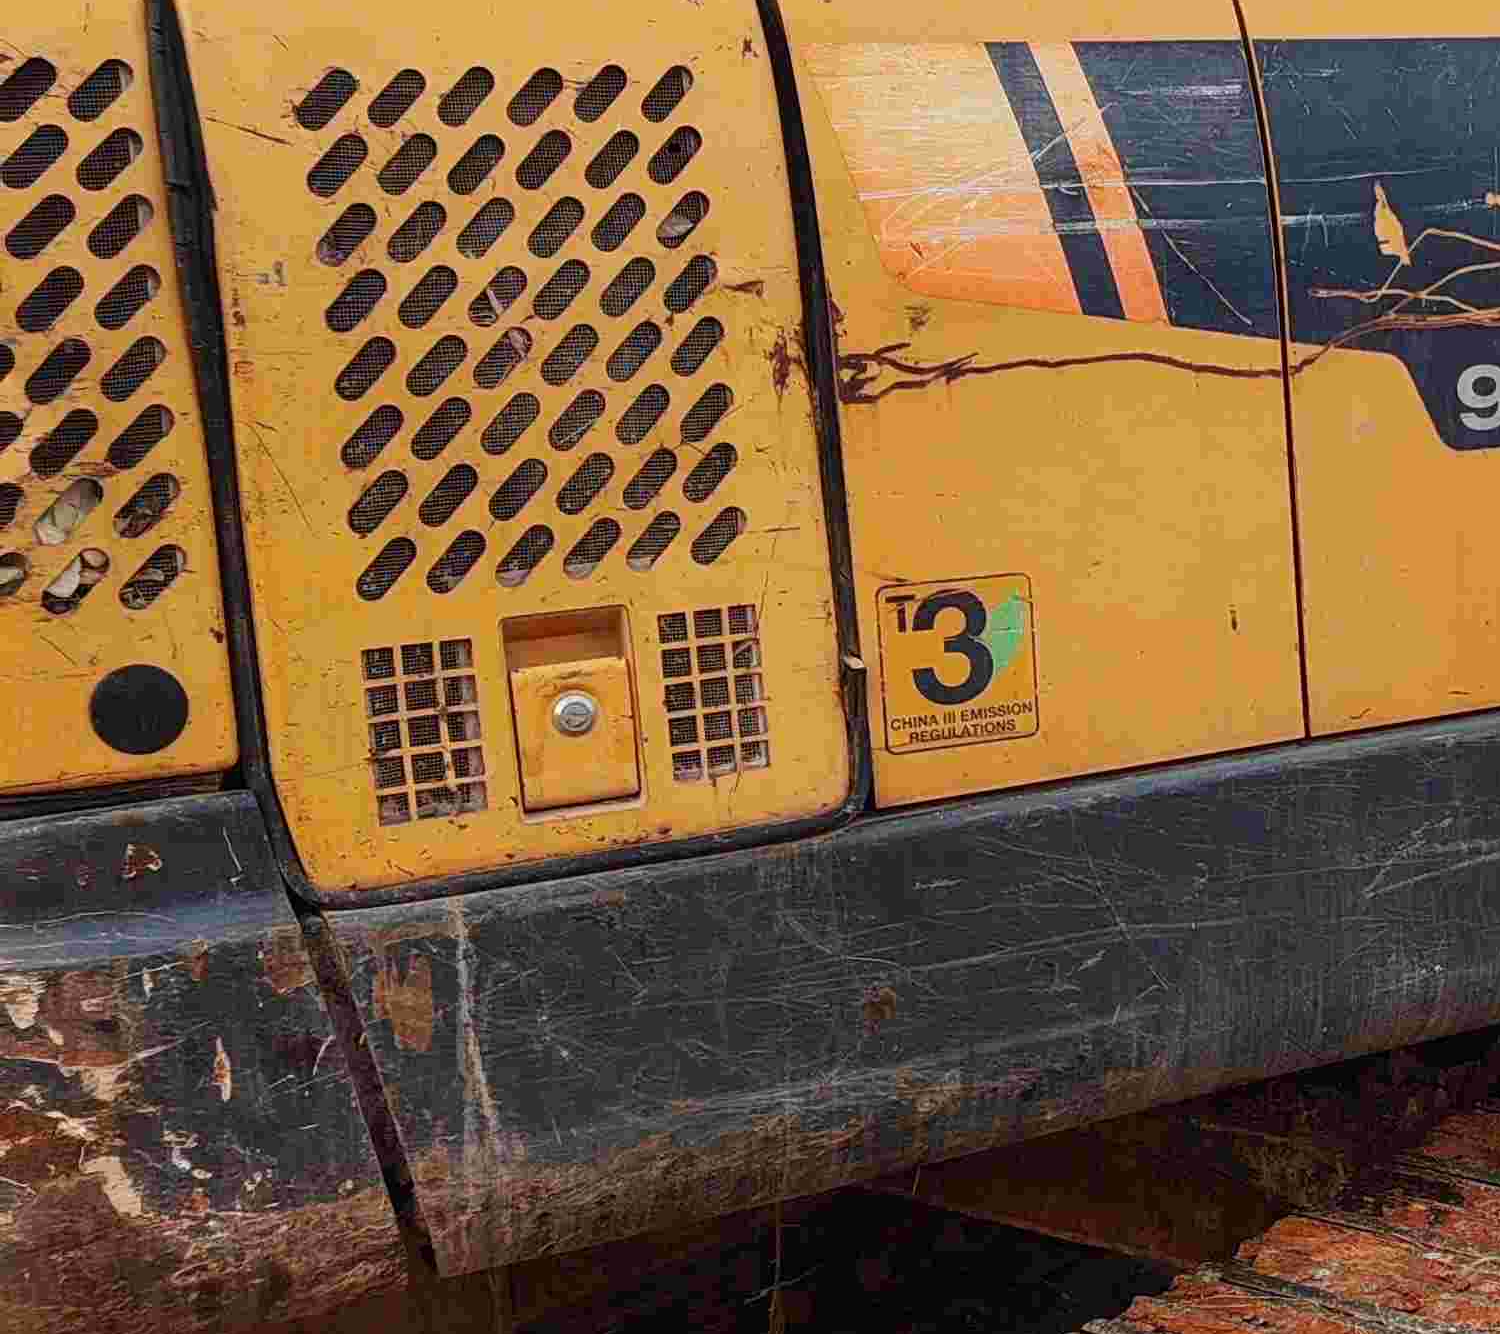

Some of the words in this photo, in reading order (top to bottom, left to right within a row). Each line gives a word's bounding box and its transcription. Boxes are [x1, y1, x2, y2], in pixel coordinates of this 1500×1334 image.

[890, 714, 938, 731] CHINA
[943, 710, 956, 724] III
[960, 701, 1033, 722] EMISSION
[909, 718, 1017, 744] REGULATIONS
